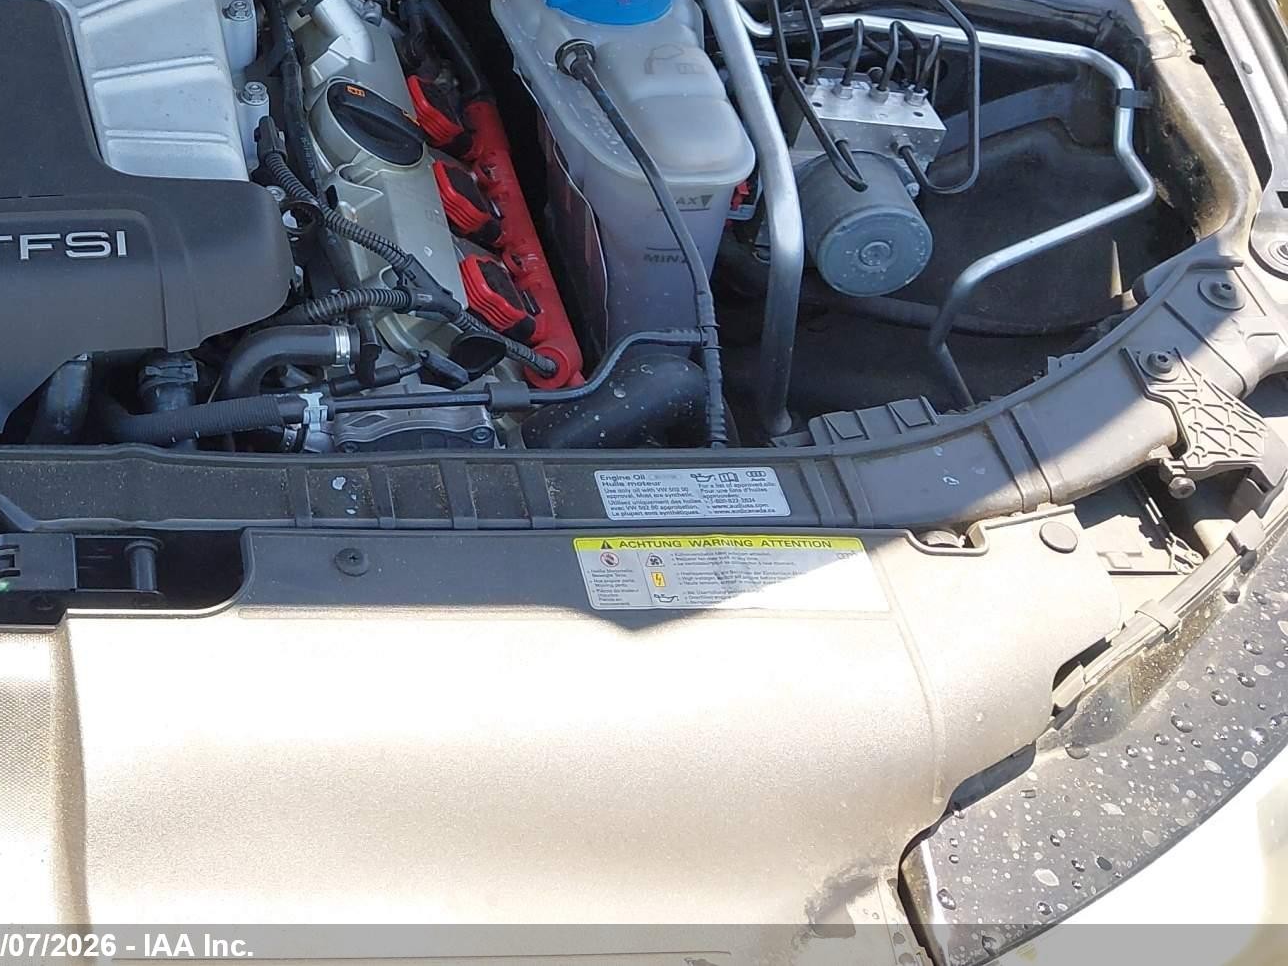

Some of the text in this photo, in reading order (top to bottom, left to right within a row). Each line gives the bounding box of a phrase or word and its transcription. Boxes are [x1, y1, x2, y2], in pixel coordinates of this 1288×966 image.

[600, 474, 631, 482] Engine
[619, 539, 833, 549] ACHTUNG WARNING ATTENTION
